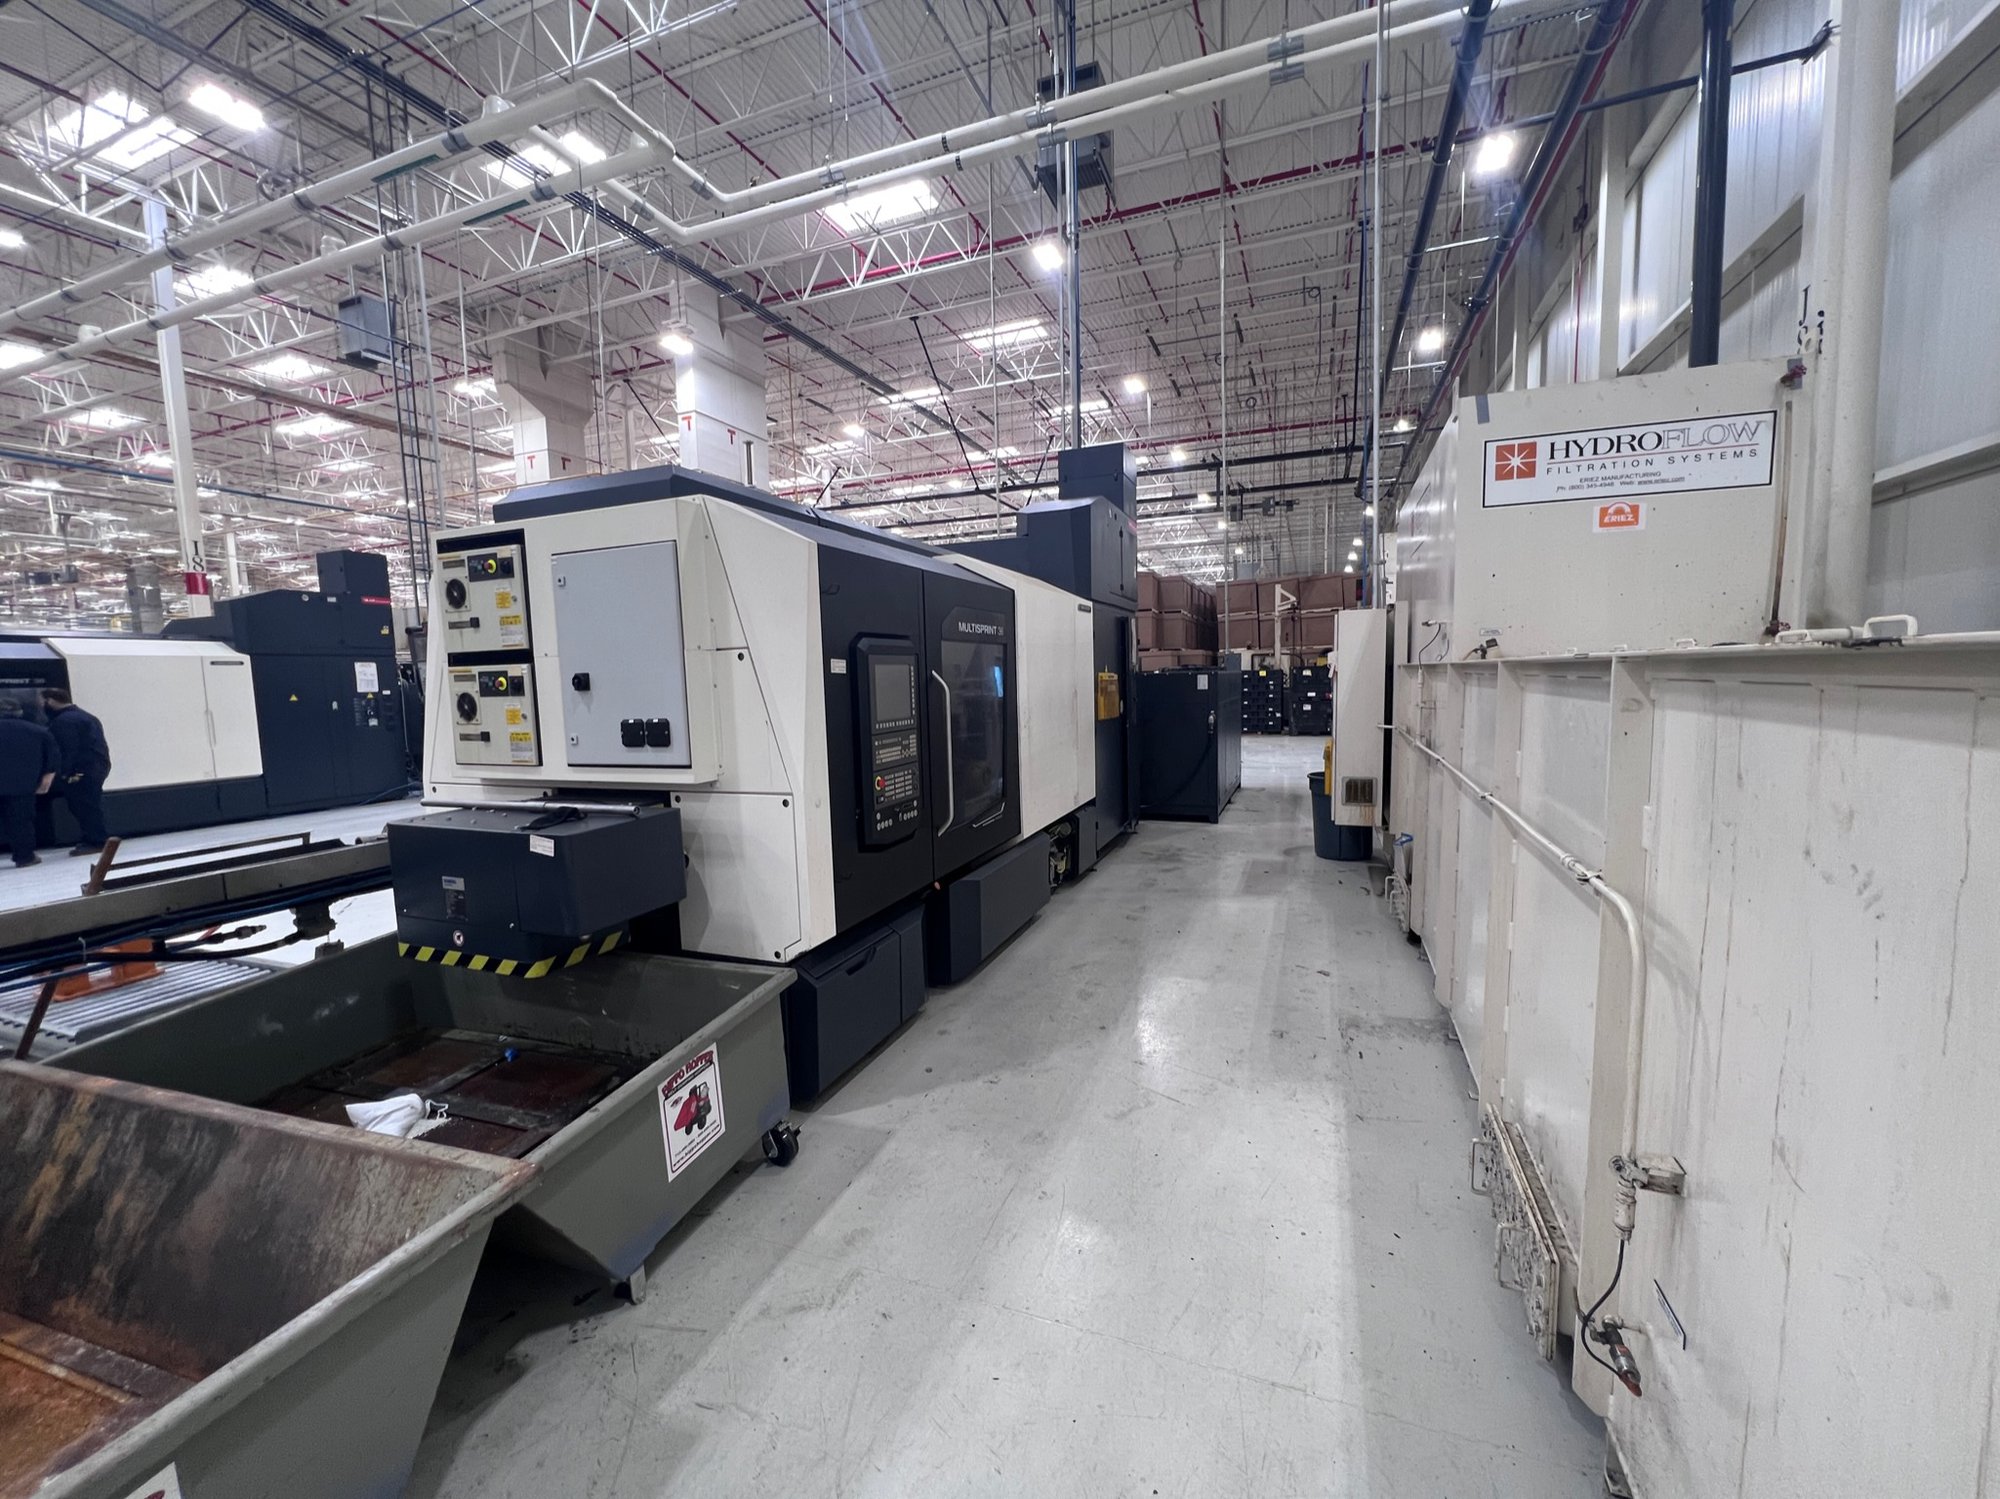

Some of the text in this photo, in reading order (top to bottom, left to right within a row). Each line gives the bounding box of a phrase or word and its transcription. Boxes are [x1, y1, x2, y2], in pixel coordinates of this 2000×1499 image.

[681, 415, 692, 431] T
[727, 428, 736, 445] T
[1548, 421, 1767, 460] HYDROFLOW
[1546, 448, 1758, 476] FILTRATION SYSTEMS
[1601, 471, 1661, 481] MANUFACTURING
[1603, 513, 1635, 523] ERIEZ
[958, 621, 997, 635] MULTISPRINT
